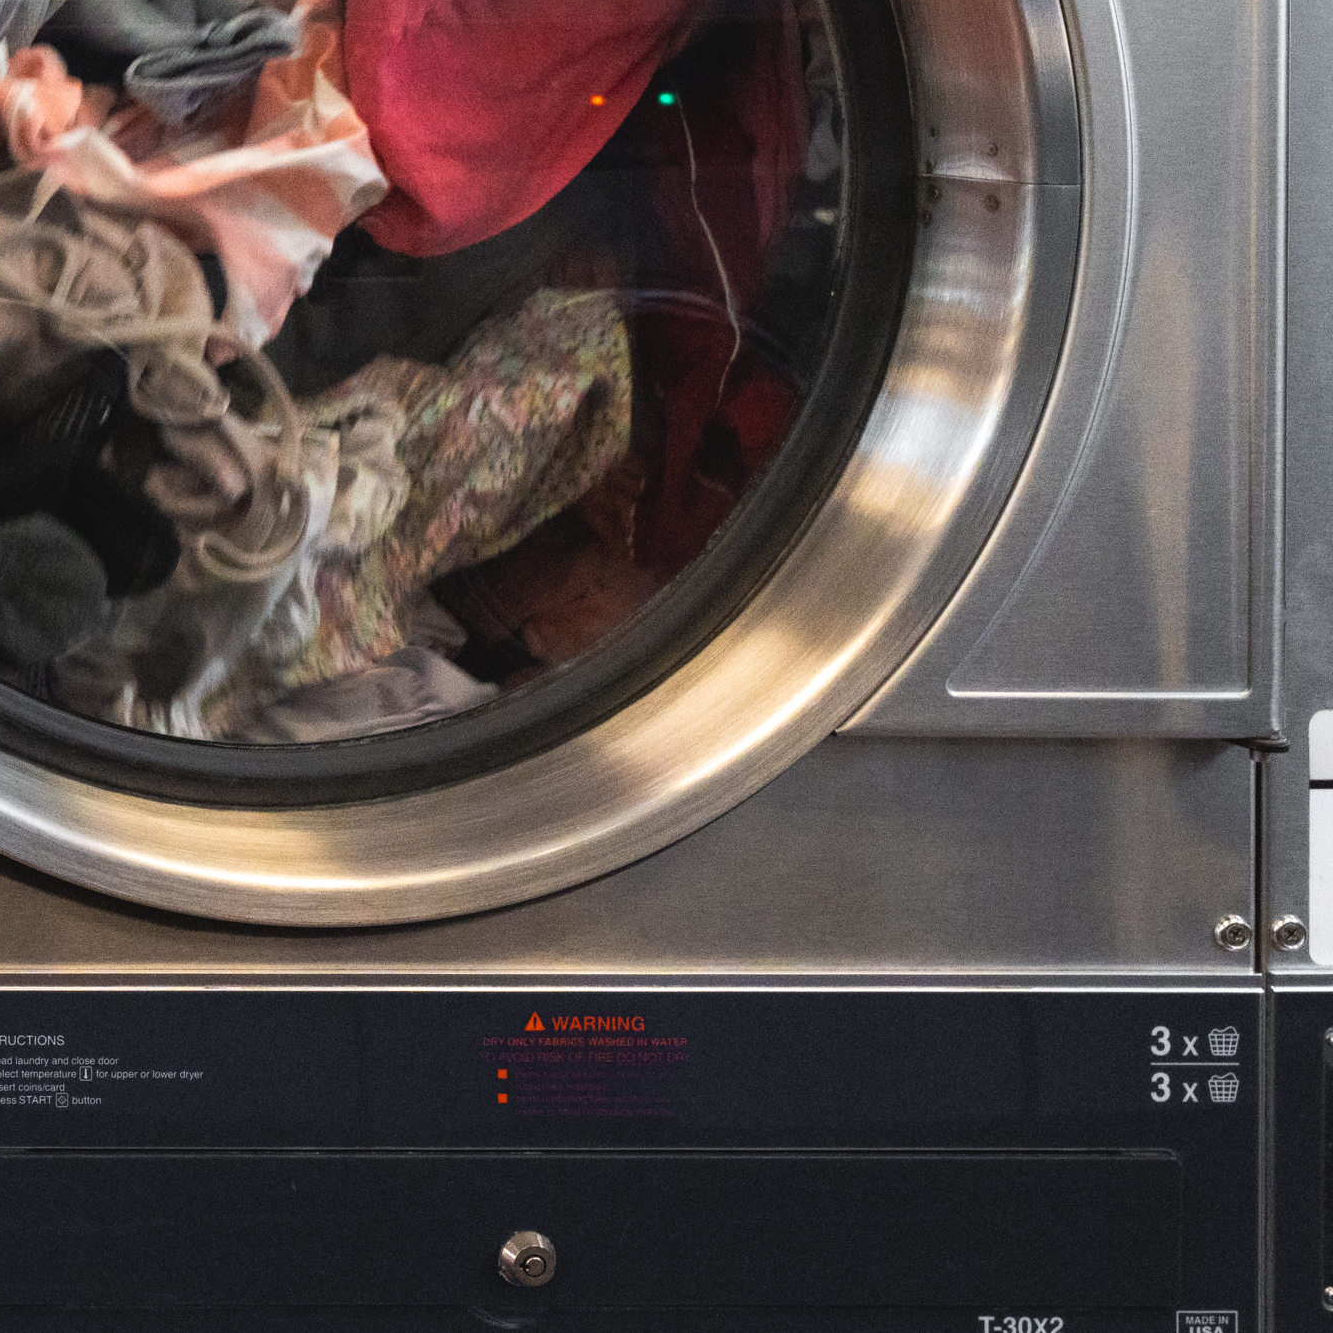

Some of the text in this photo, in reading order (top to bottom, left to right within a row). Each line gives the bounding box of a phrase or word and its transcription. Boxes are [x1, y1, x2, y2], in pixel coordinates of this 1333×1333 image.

[551, 1016, 645, 1032] WARNING
[1151, 1026, 1171, 1056] 3
[15, 1056, 49, 1067] laundry
[51, 1056, 69, 1065] and
[71, 1056, 96, 1065] close
[98, 1056, 119, 1065] door
[21, 1069, 77, 1080] temperature
[96, 1069, 109, 1078] for
[111, 1071, 137, 1081] upper
[140, 1071, 150, 1079] or
[152, 1069, 177, 1079] lower
[179, 1069, 204, 1081] dryer
[18, 1082, 65, 1092] coins/card
[1151, 1072, 1171, 1102] 3
[18, 1095, 53, 1104] START
[71, 1095, 102, 1105] button
[978, 1316, 1064, 1333] T-30X2
[1185, 1315, 1229, 1325] MADE IN
